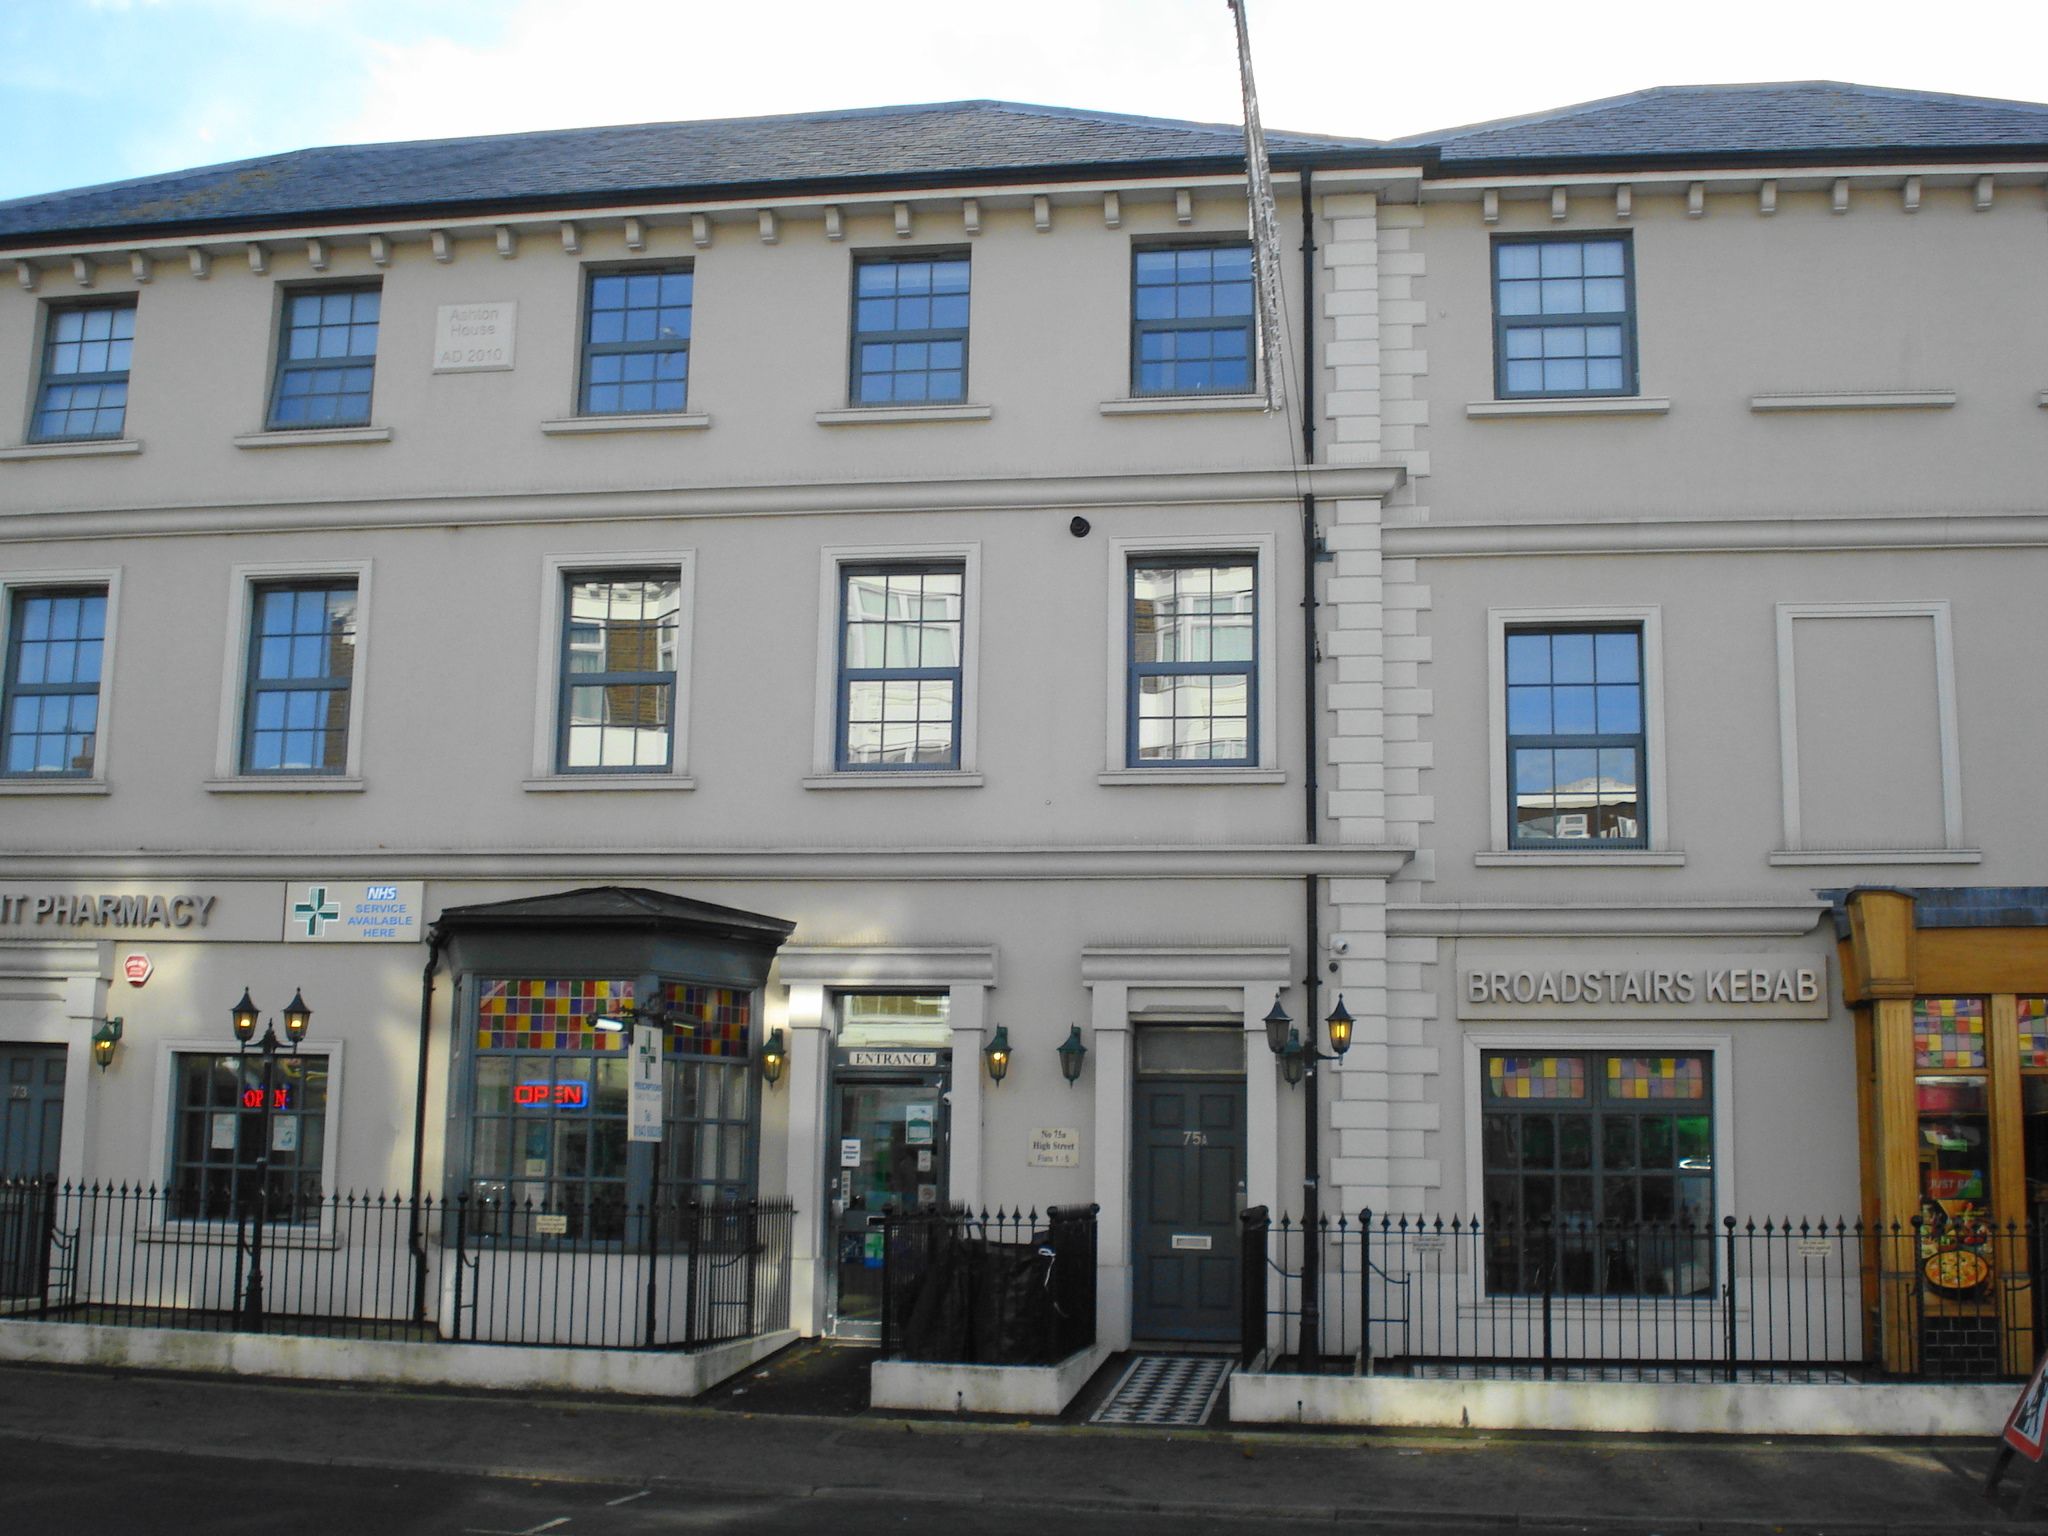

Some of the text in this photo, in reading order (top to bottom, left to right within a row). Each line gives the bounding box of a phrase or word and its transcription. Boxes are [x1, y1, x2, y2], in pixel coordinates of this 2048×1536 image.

[450, 324, 496, 337] House
[440, 348, 503, 363] AD 2010
[368, 886, 397, 900] NHS
[33, 894, 216, 927] PHARMACY
[355, 904, 407, 914] SERVICE
[347, 916, 414, 926] AVAILABLE
[363, 928, 396, 938] HERE
[1468, 969, 1819, 1003] BROADSTAIRS KEBAB
[856, 1053, 932, 1065] ENTRANCE
[12, 1086, 28, 1099] 73
[244, 1089, 288, 1108] OPN
[514, 1086, 582, 1104] OPEN
[1033, 1141, 1074, 1151] High Street
